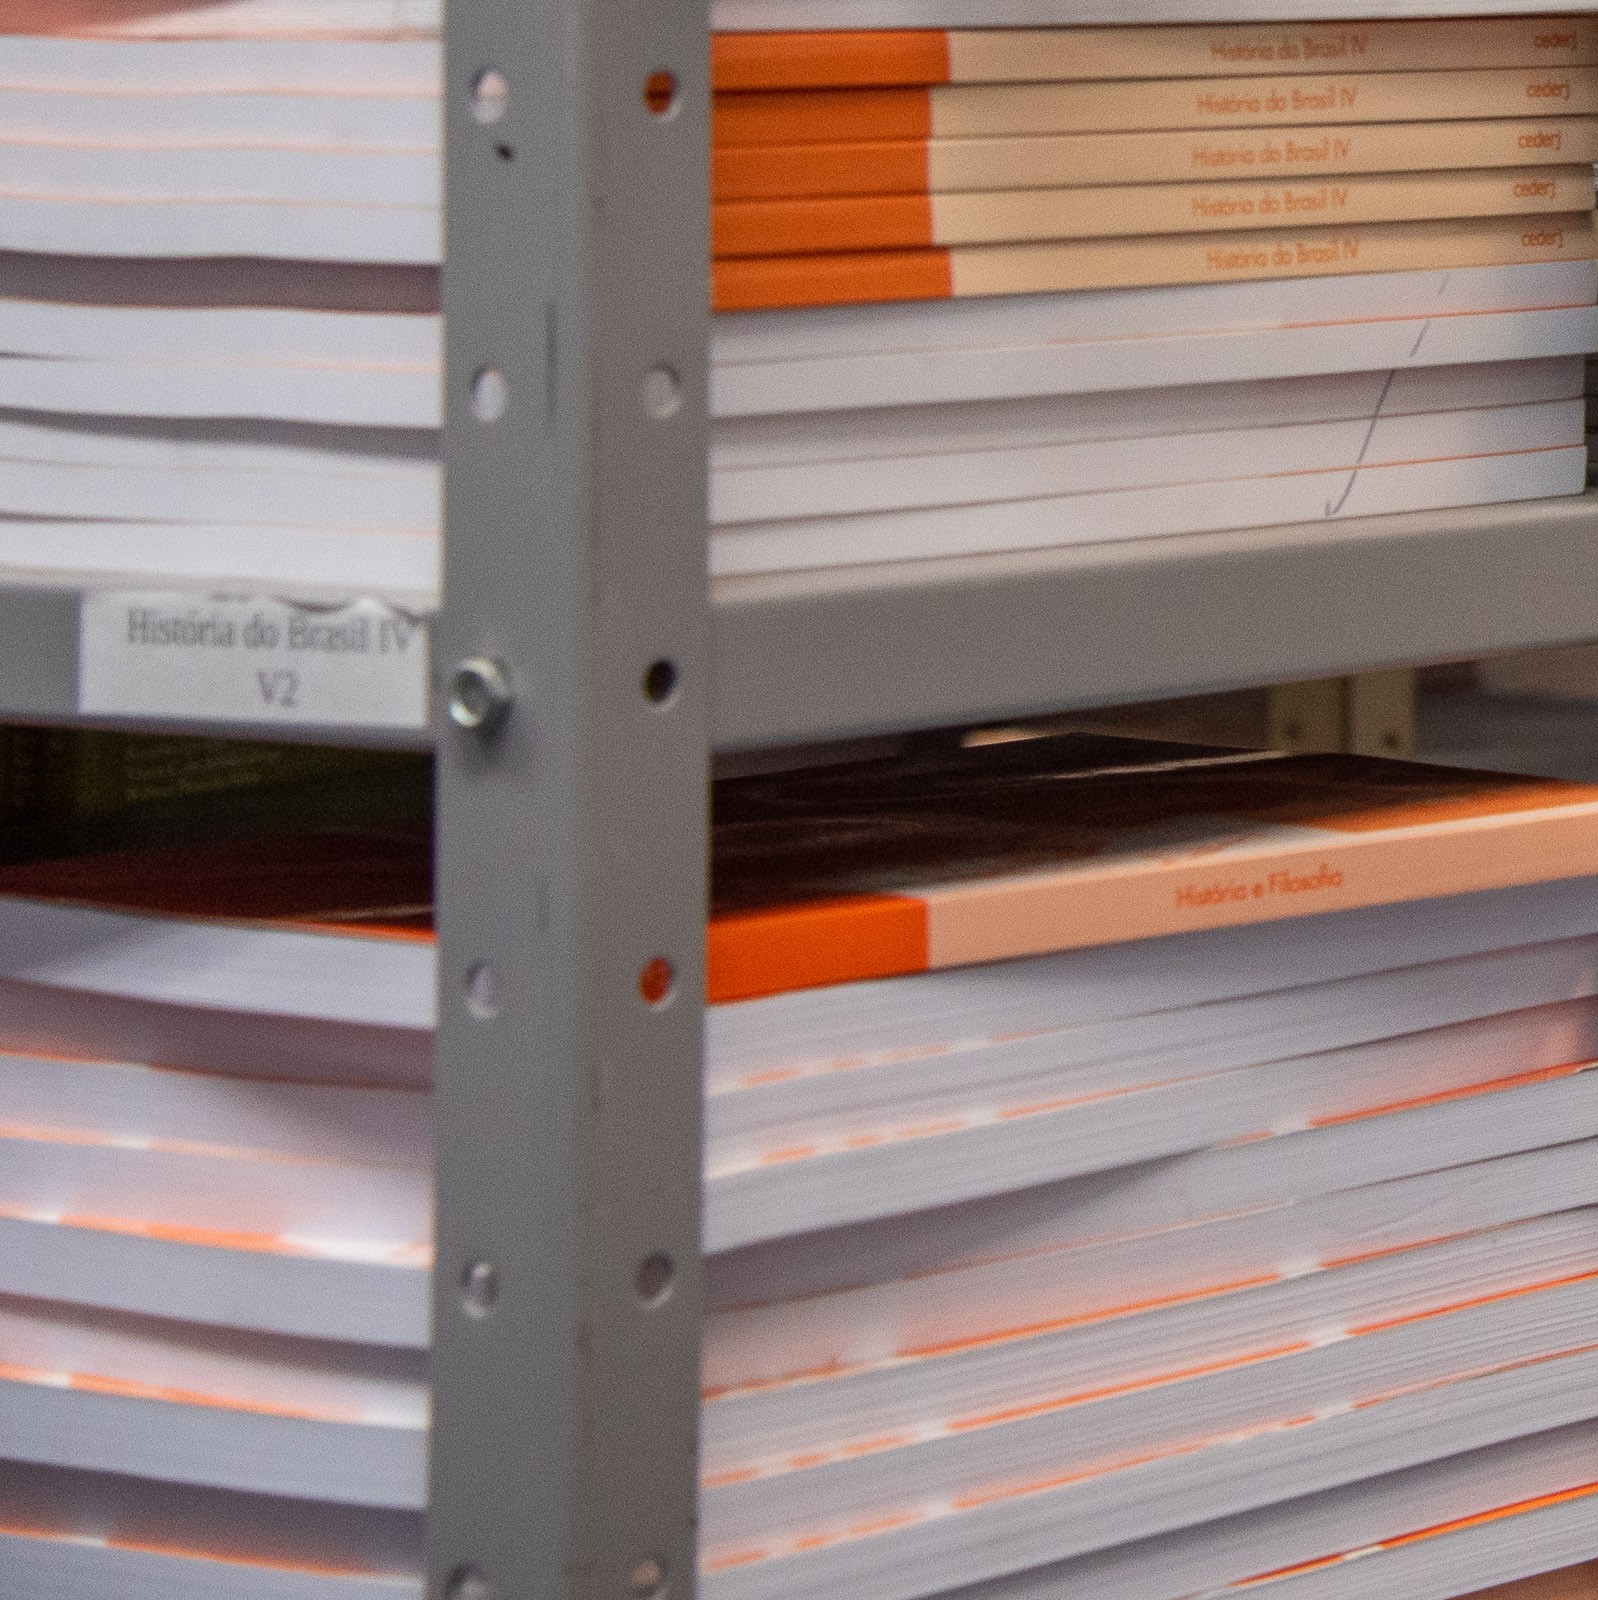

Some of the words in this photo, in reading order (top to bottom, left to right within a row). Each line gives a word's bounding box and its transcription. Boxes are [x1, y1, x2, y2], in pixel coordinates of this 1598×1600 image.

[126, 607, 235, 649] História
[242, 612, 280, 649] do
[287, 614, 370, 654] Brasil
[257, 668, 299, 707] V2
[1175, 882, 1247, 908] História
[1268, 863, 1344, 894] Filosofia
